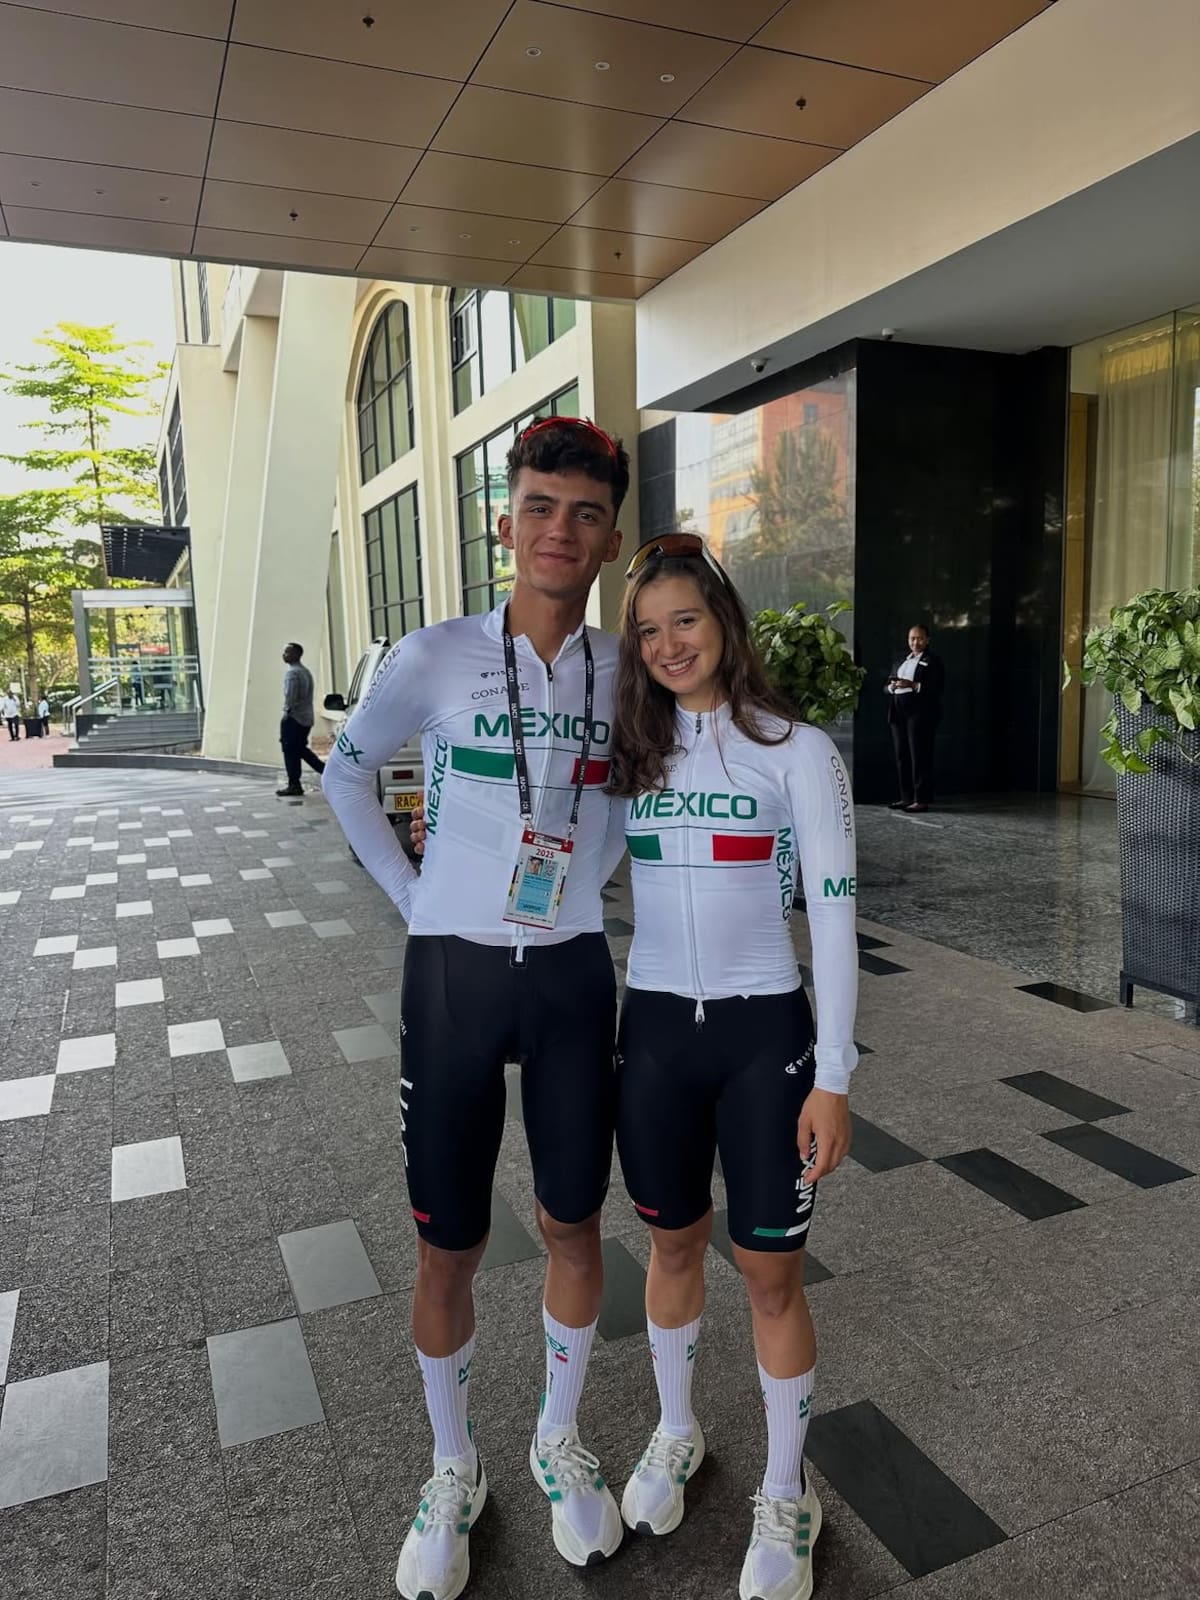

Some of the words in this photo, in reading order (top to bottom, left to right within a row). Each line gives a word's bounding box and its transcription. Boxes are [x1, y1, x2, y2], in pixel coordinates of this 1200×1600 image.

[471, 682, 530, 700] CONAE
[337, 732, 364, 764] EX
[630, 788, 757, 820] MÉXICO
[831, 756, 852, 838] CONADE
[536, 848, 555, 859] 2025
[824, 877, 856, 897] ME
